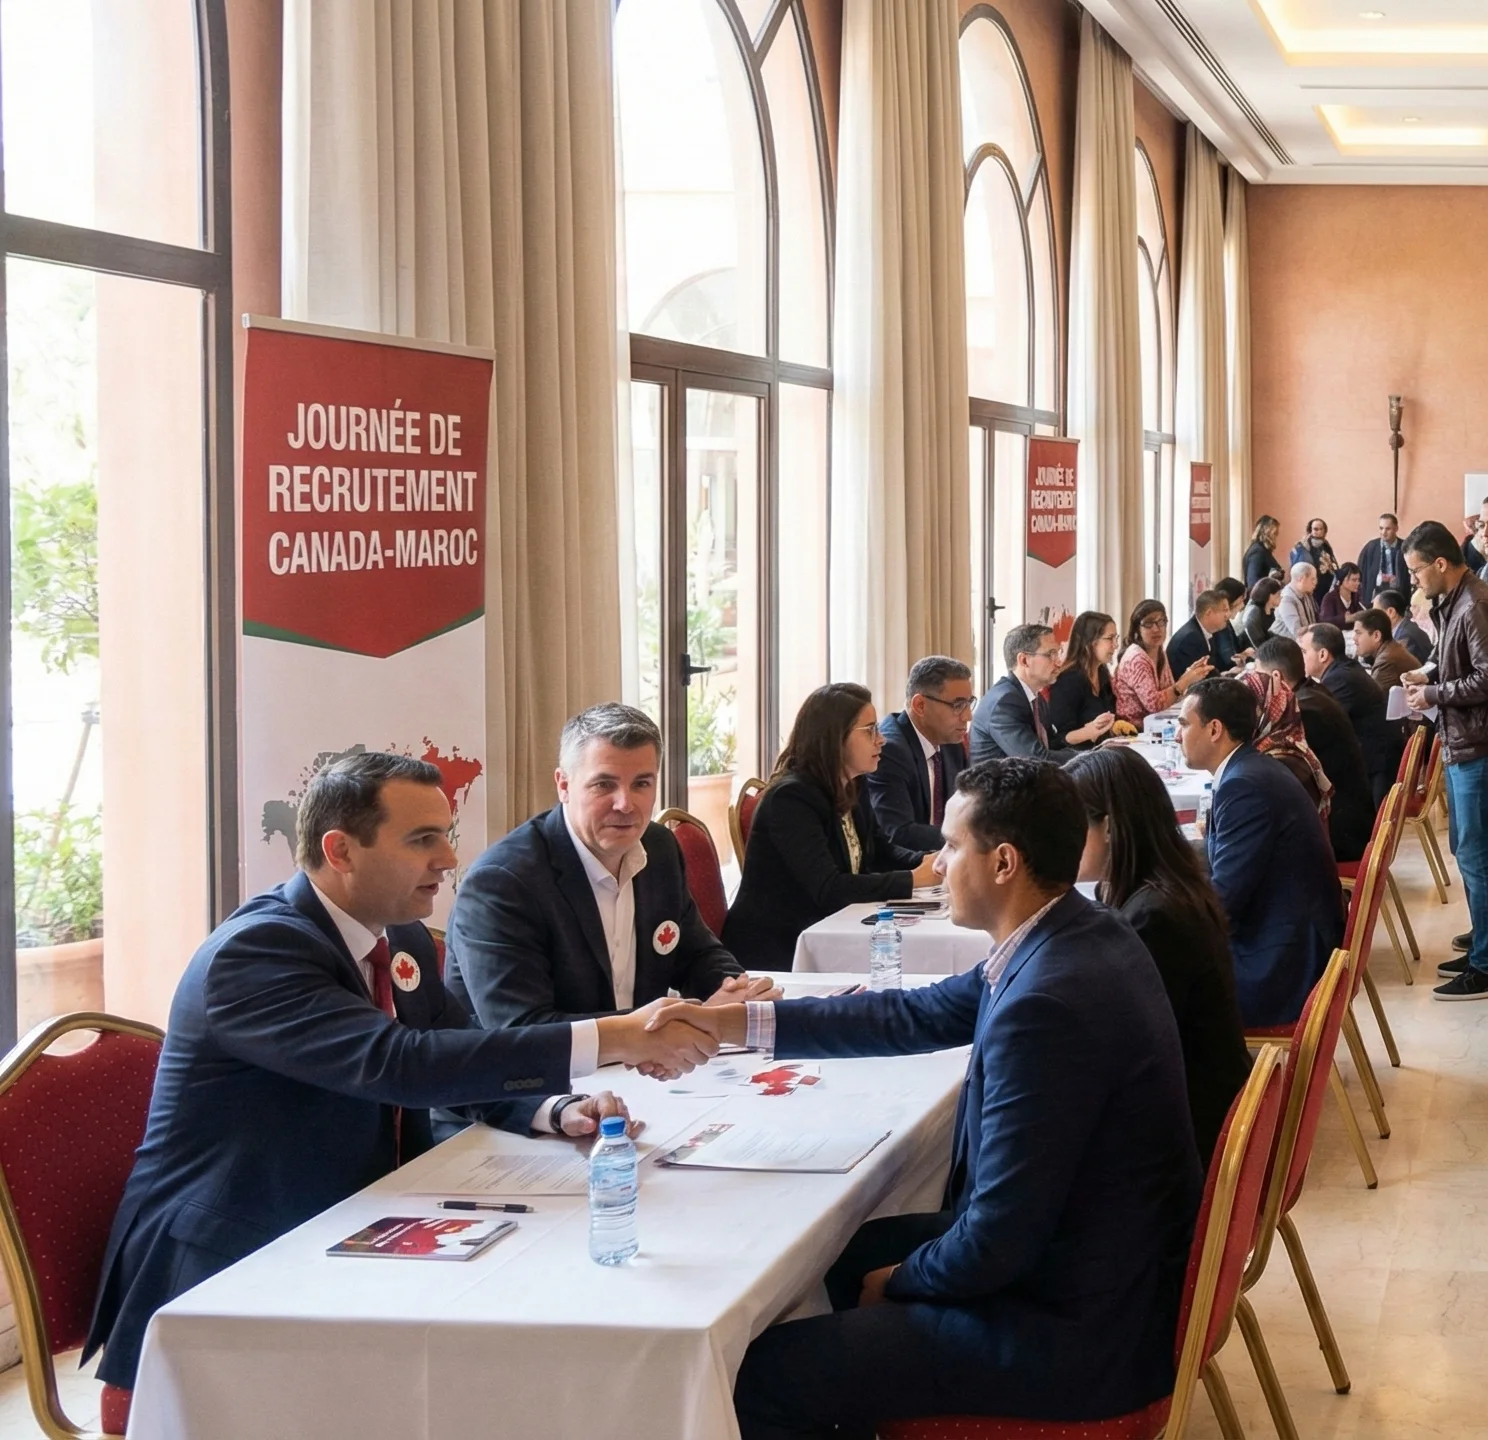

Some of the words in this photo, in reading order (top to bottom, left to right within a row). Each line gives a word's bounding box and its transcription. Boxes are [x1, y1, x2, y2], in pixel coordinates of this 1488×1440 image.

[287, 398, 421, 454] JOURNÉE
[429, 413, 461, 456] DE
[269, 465, 477, 512] RECRUTEMENT
[269, 528, 478, 575] CANADA-MAROC
